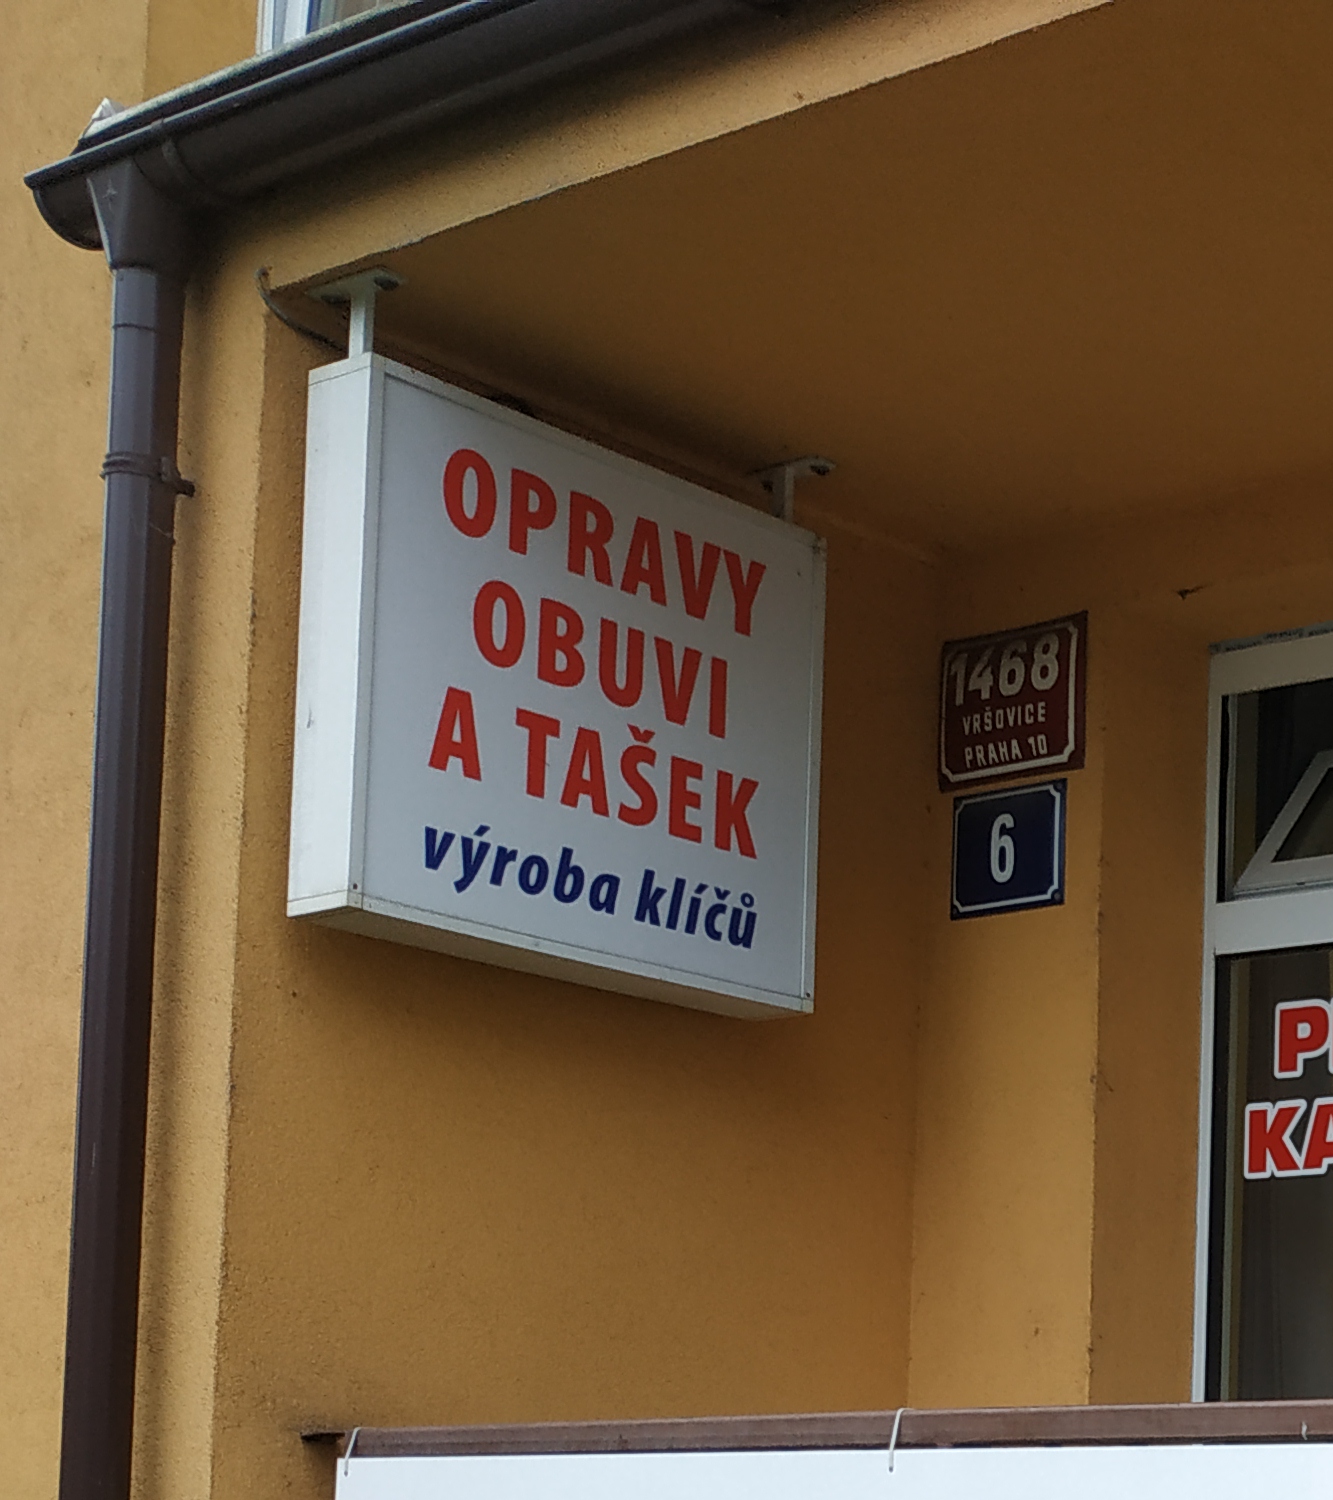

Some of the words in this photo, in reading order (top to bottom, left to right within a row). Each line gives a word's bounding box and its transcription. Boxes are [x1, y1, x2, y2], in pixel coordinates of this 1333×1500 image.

[443, 449, 766, 637] OPRAVY
[473, 580, 728, 740] OBUVI
[950, 632, 1060, 707] 1468
[963, 701, 1046, 735] VRŠOVICE
[964, 738, 1023, 769] PRAHA
[1028, 734, 1048, 757] 10
[428, 687, 482, 782] A
[516, 708, 759, 861] TAŠEK
[423, 826, 619, 916] výroba
[634, 869, 758, 950] klíčů
[990, 813, 1015, 883] 6
